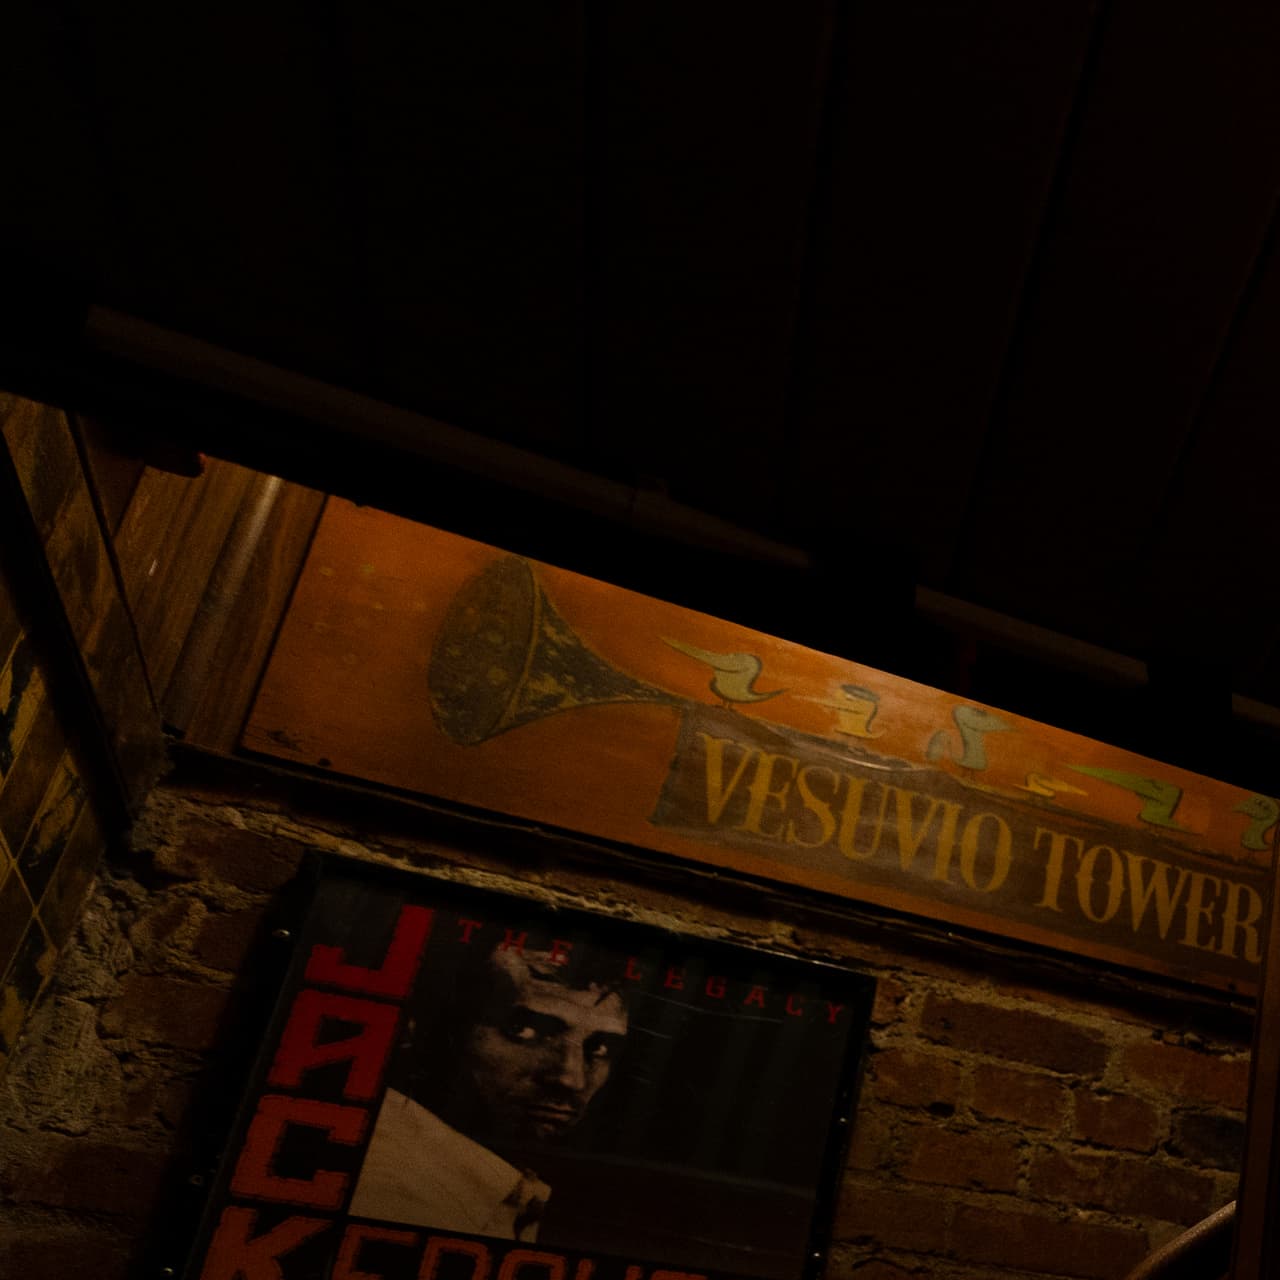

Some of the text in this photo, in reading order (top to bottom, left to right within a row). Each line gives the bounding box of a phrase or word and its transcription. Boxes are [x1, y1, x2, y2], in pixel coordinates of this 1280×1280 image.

[697, 731, 1264, 963] VESUVIO TOWER
[455, 917, 849, 1025] THE LEGACY
